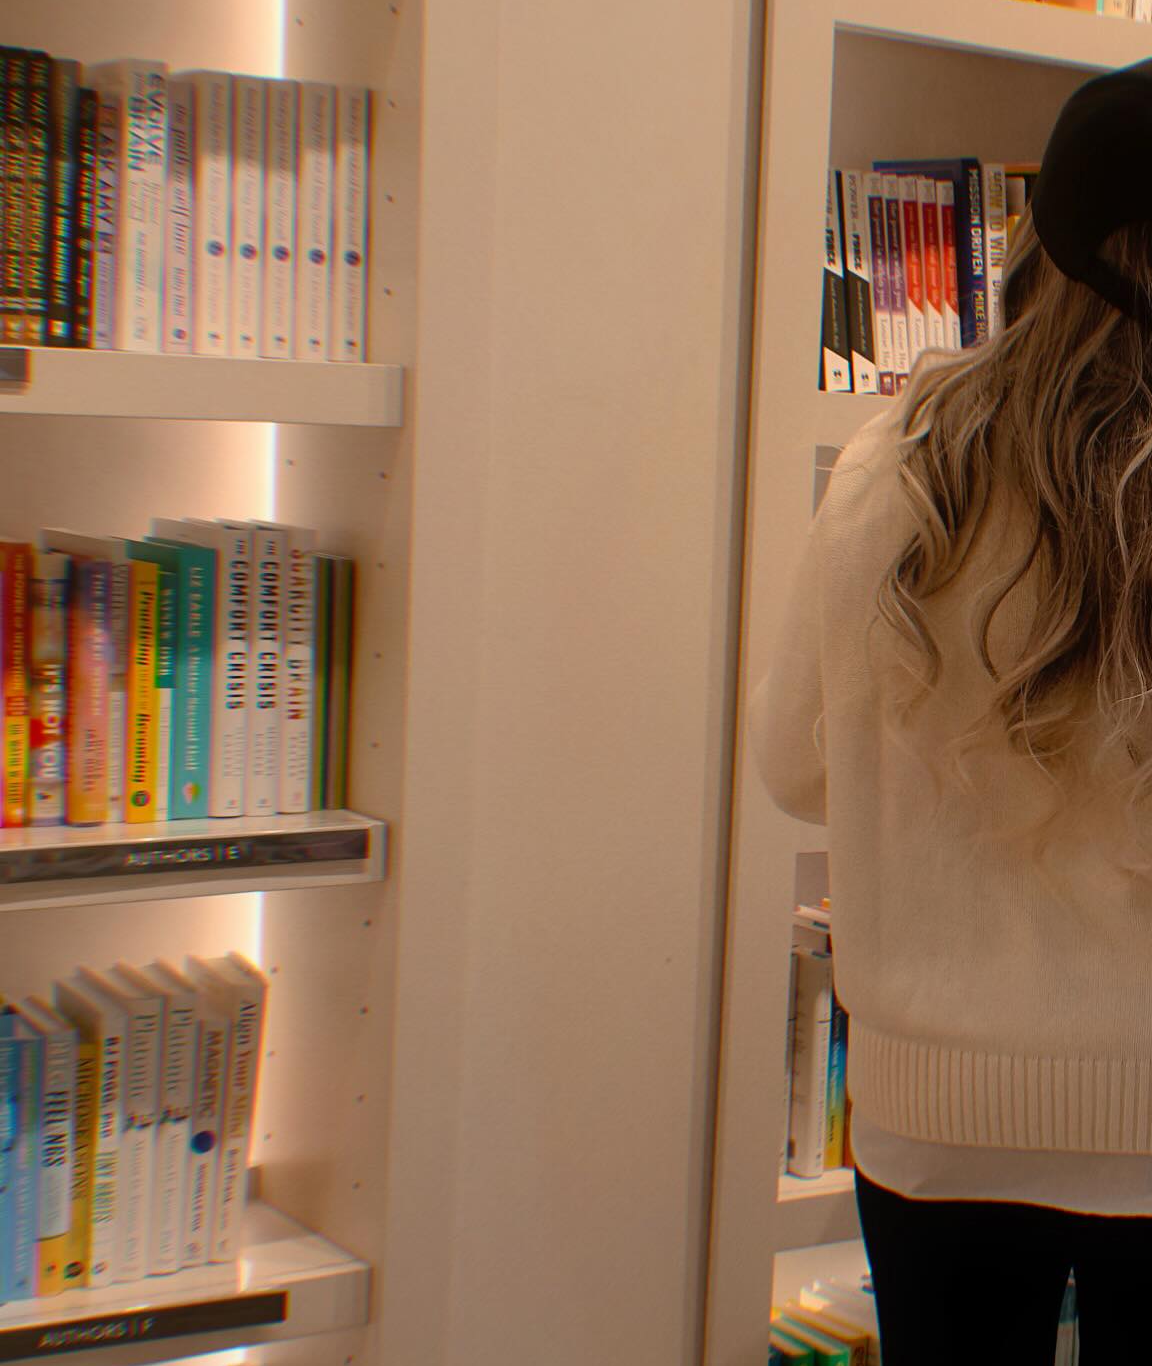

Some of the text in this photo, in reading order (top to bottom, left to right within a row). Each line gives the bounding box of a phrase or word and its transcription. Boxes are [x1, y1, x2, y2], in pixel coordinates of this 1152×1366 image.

[129, 98, 145, 172] BRAIN
[149, 73, 164, 166] EVOLVE
[171, 128, 190, 165] path
[98, 134, 112, 223] ASK AMY
[988, 170, 1003, 206] HOW
[6, 181, 24, 251] SUPERIOR
[31, 182, 47, 252] SUPERIOR
[851, 233, 862, 270] FORCE
[968, 168, 985, 320] MISSION DRIVEN MIKE
[990, 236, 1005, 268] WIN
[6, 255, 22, 289] MAN
[31, 257, 46, 290] MAN
[227, 560, 248, 711] COMFORT CRISIS
[257, 560, 281, 711] COMFORT CRISIS
[285, 658, 310, 720] BRAIN
[43, 699, 64, 735] NOT
[42, 741, 64, 778] YOU
[127, 847, 214, 866] AUTHORS
[238, 1001, 257, 1044] Align
[199, 1030, 224, 1118] MAGNETIC
[231, 1049, 253, 1090] Your
[43, 1089, 70, 1168] FEELNGS
[227, 1095, 249, 1140] Mind
[39, 1318, 127, 1347] AUTHORS
